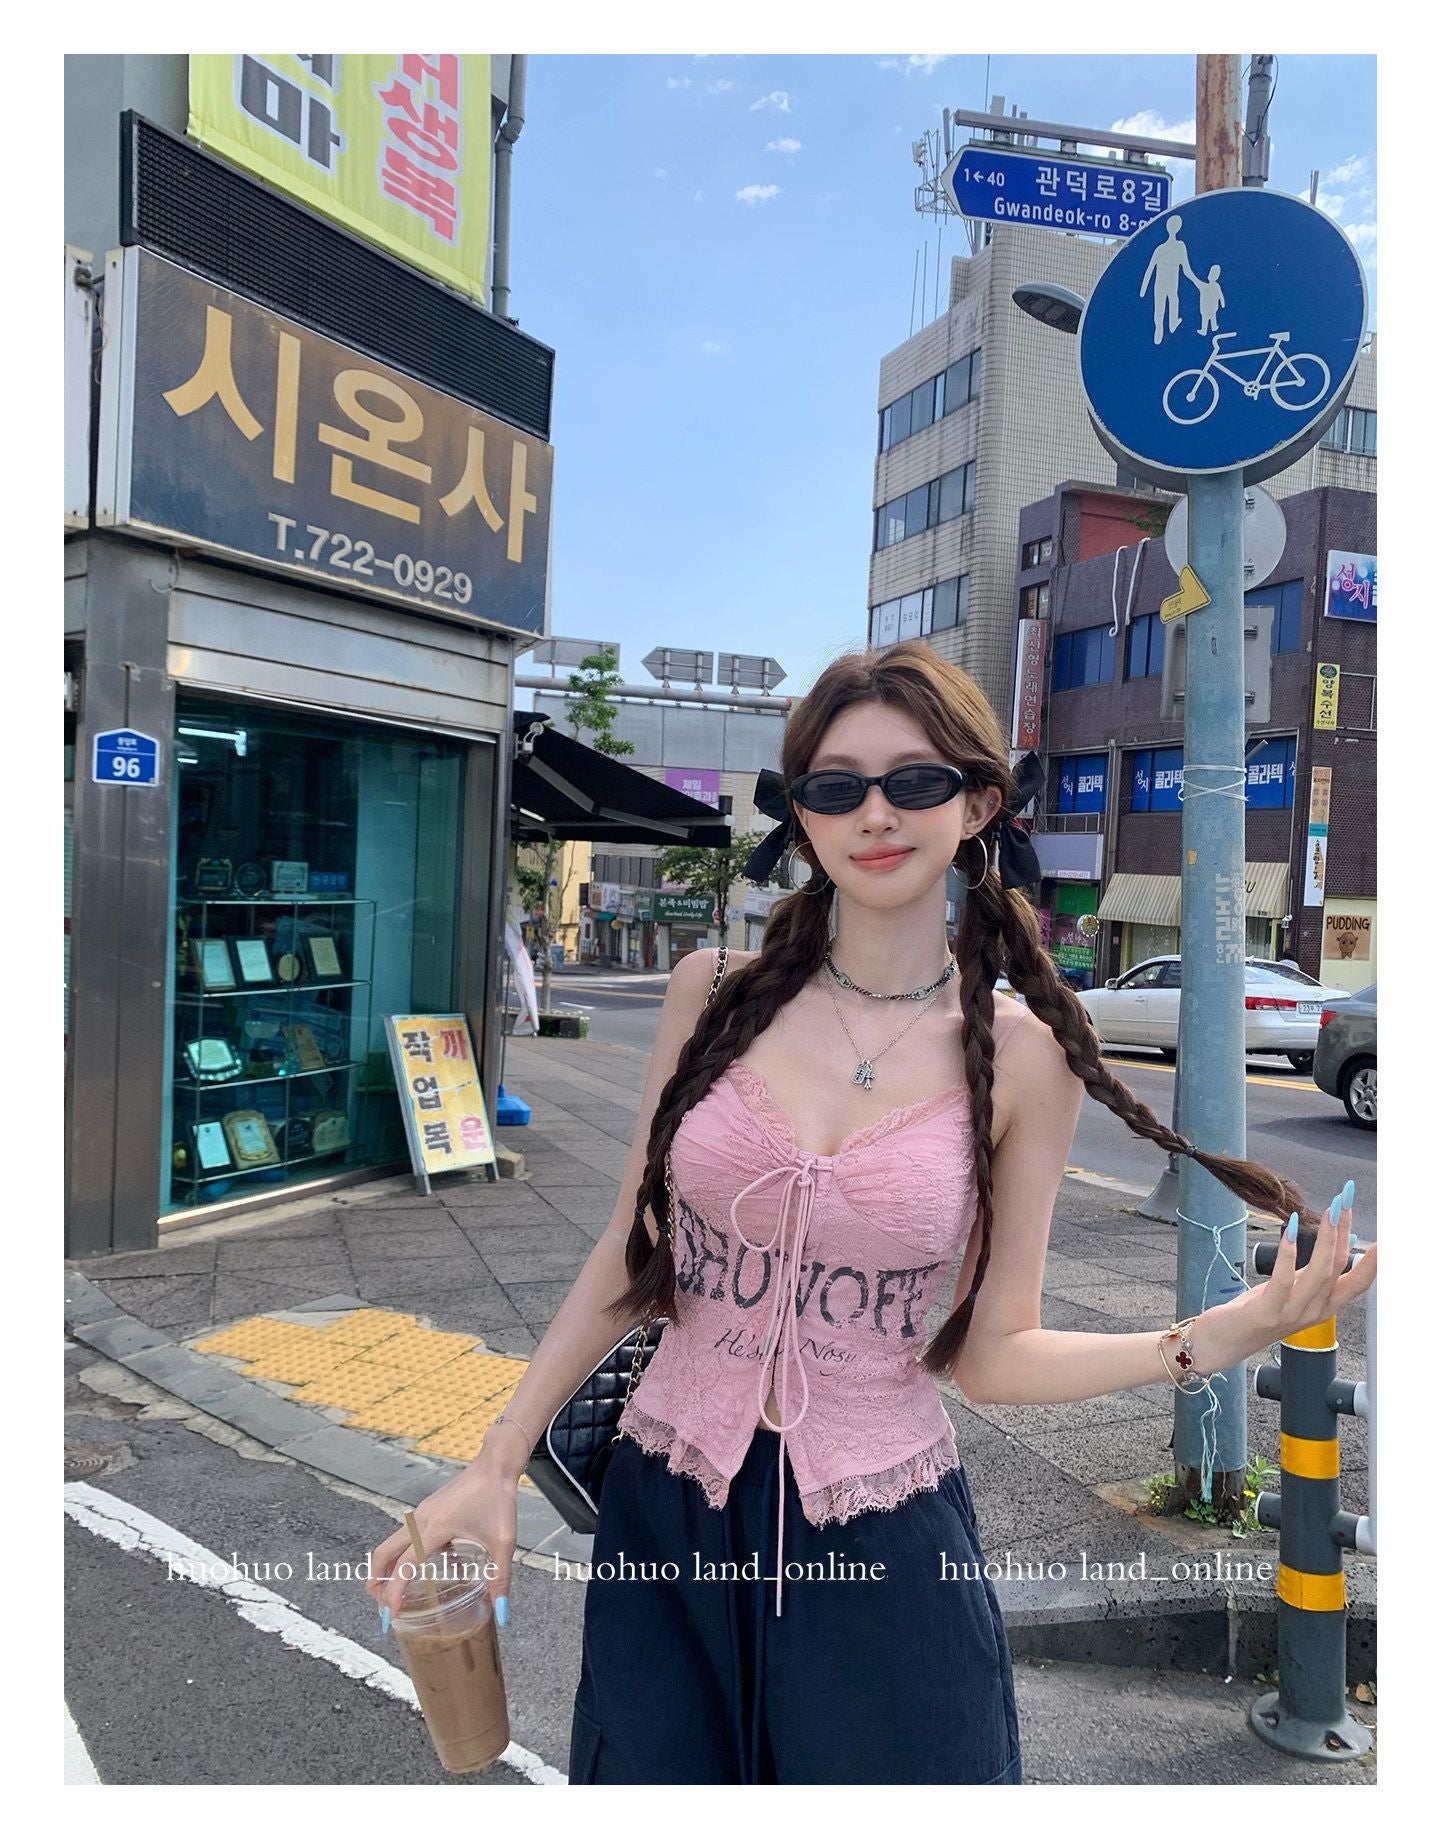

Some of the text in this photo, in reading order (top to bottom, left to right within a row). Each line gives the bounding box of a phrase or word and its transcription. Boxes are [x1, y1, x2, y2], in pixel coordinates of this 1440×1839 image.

[986, 171, 1005, 187] 40
[1035, 166, 1161, 212] 관덕로8길
[994, 196, 1111, 229] Gwandeok-ro
[162, 305, 537, 563] 시온사
[268, 512, 473, 604] T.722-0929
[1335, 563, 1370, 609] 성지
[1320, 679, 1335, 719] 양복수선
[112, 756, 141, 778] 96
[1134, 769, 1149, 793] 성지
[1247, 763, 1283, 785] 콜라텍
[1061, 774, 1103, 796] 성지 콜라텍
[1326, 916, 1371, 931] PUDDING
[402, 1031, 452, 1154] 작업복
